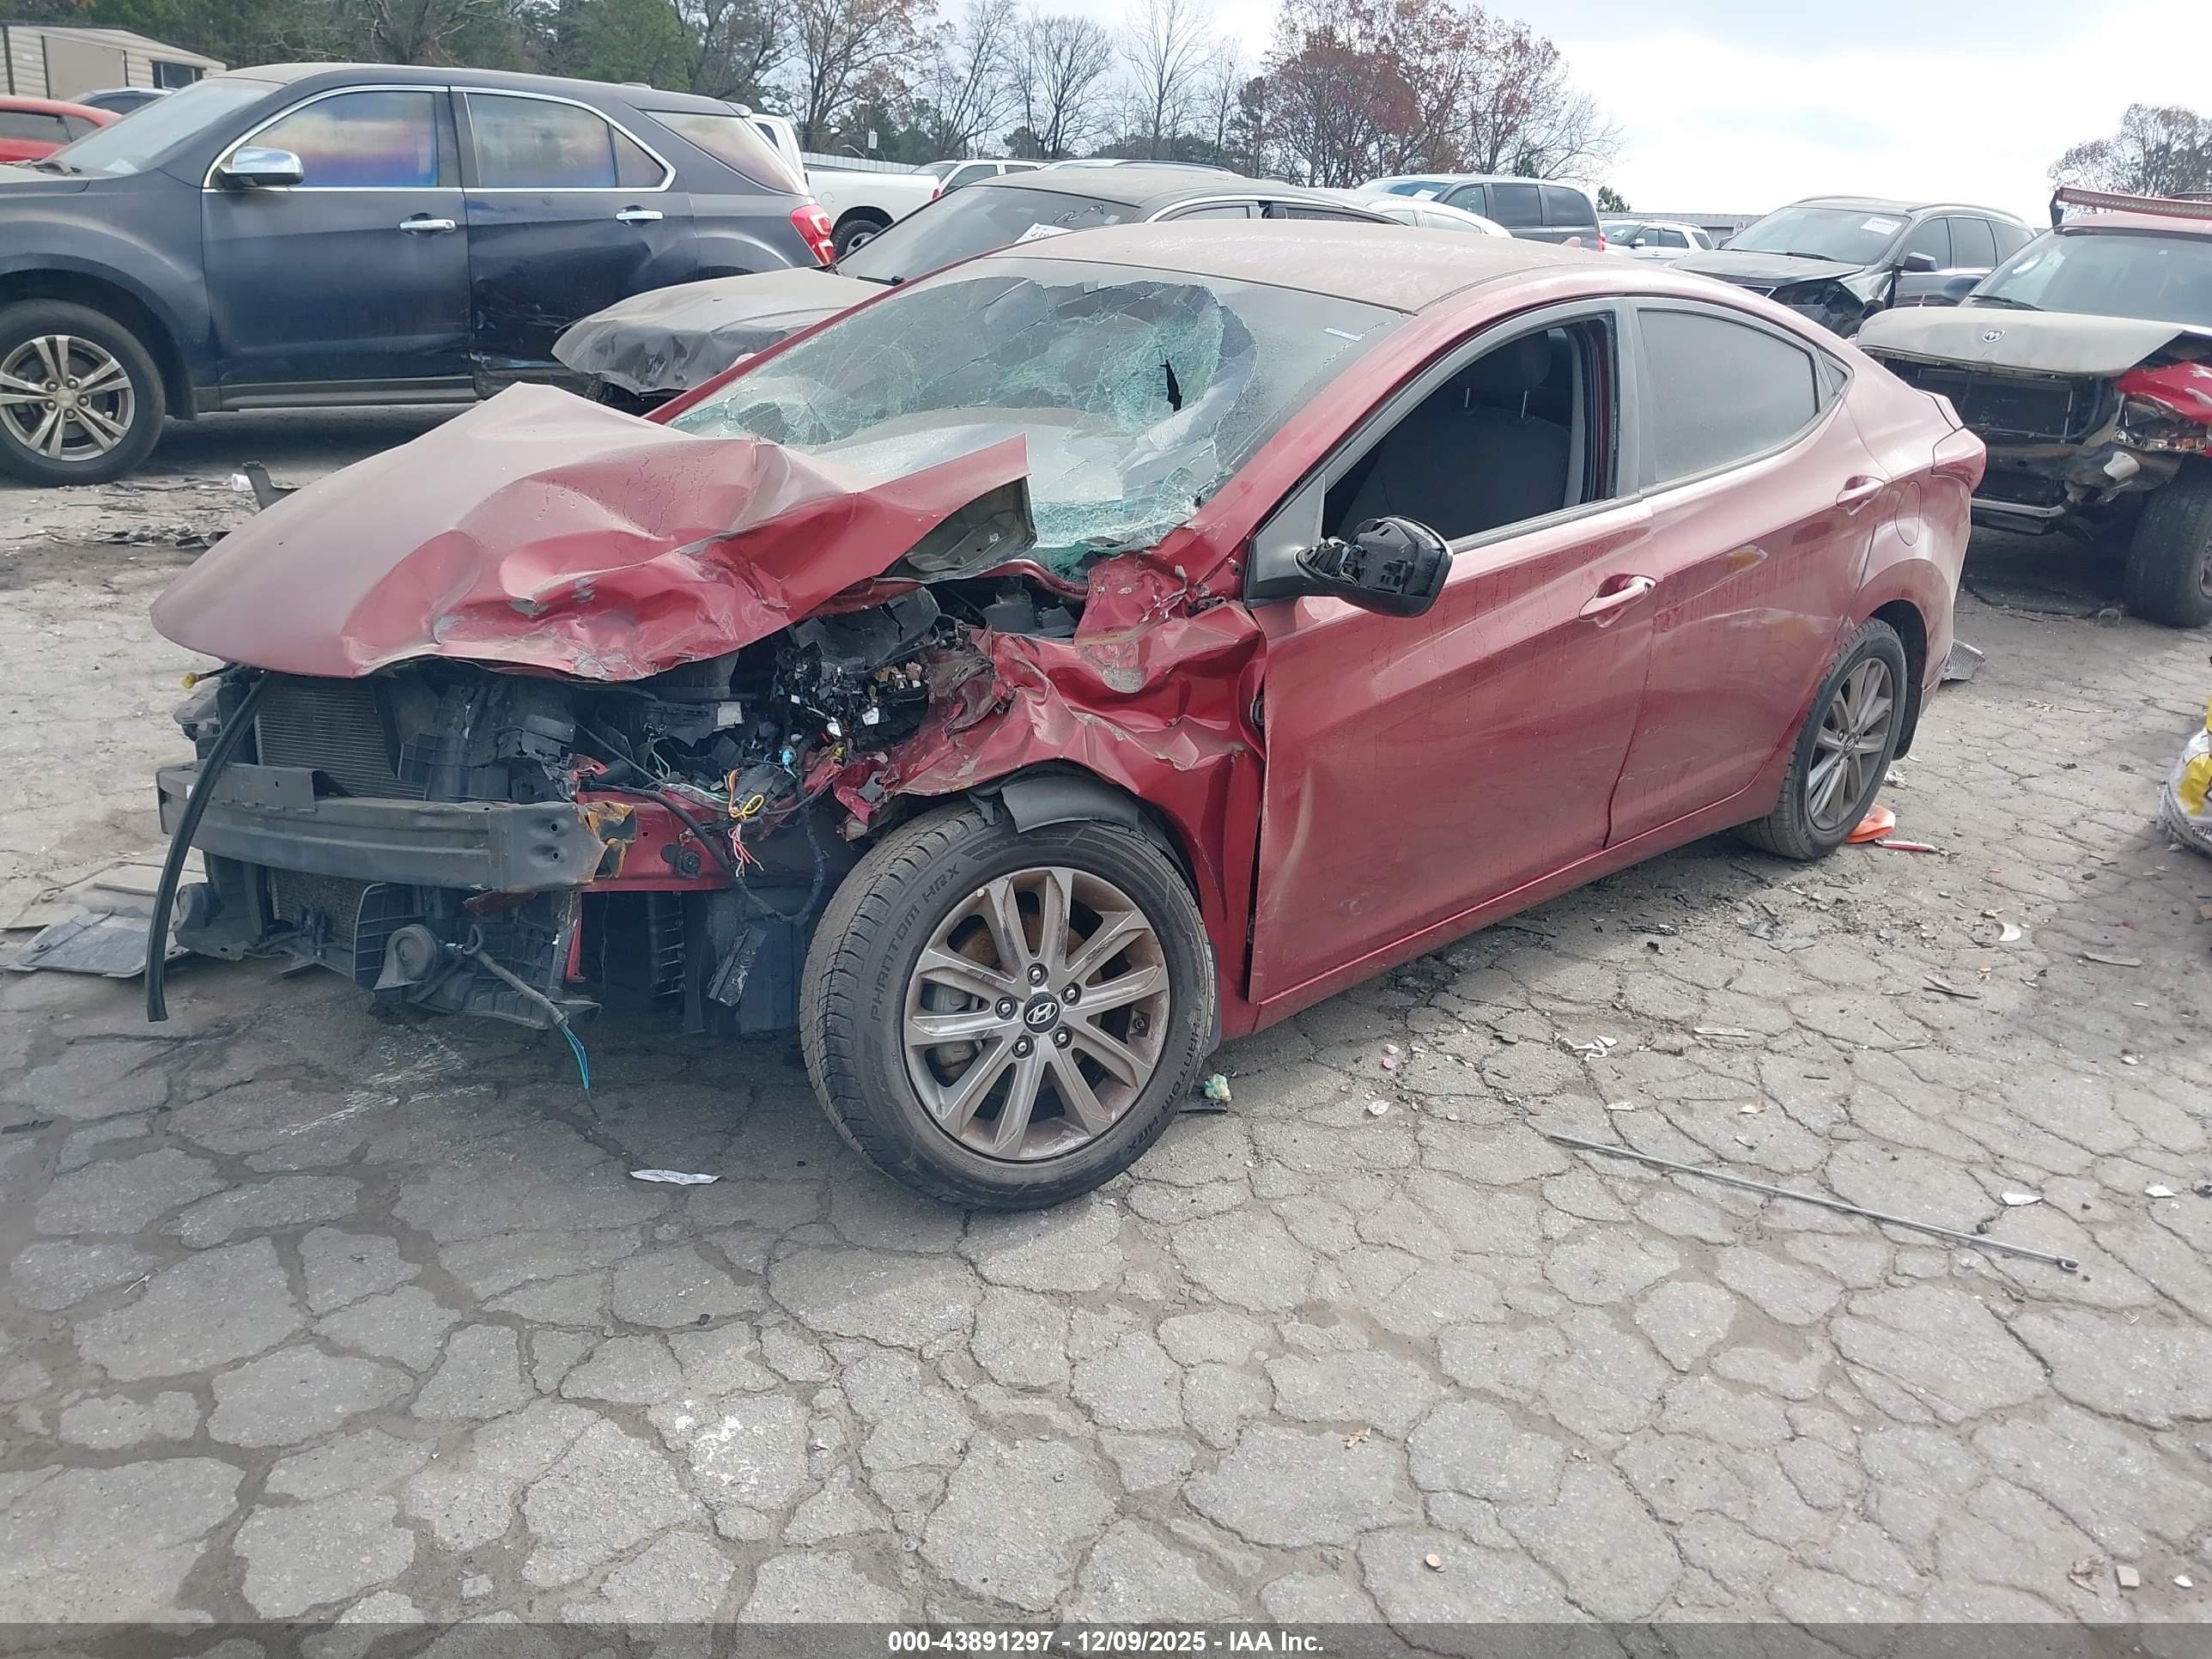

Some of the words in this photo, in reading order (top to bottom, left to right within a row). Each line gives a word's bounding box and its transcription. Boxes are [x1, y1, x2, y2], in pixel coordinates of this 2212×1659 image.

[870, 904, 921, 1023] PHANTOM
[921, 864, 961, 903] HRX
[1161, 1007, 1202, 1113] PHANTOM
[1126, 1116, 1159, 1154] HRX
